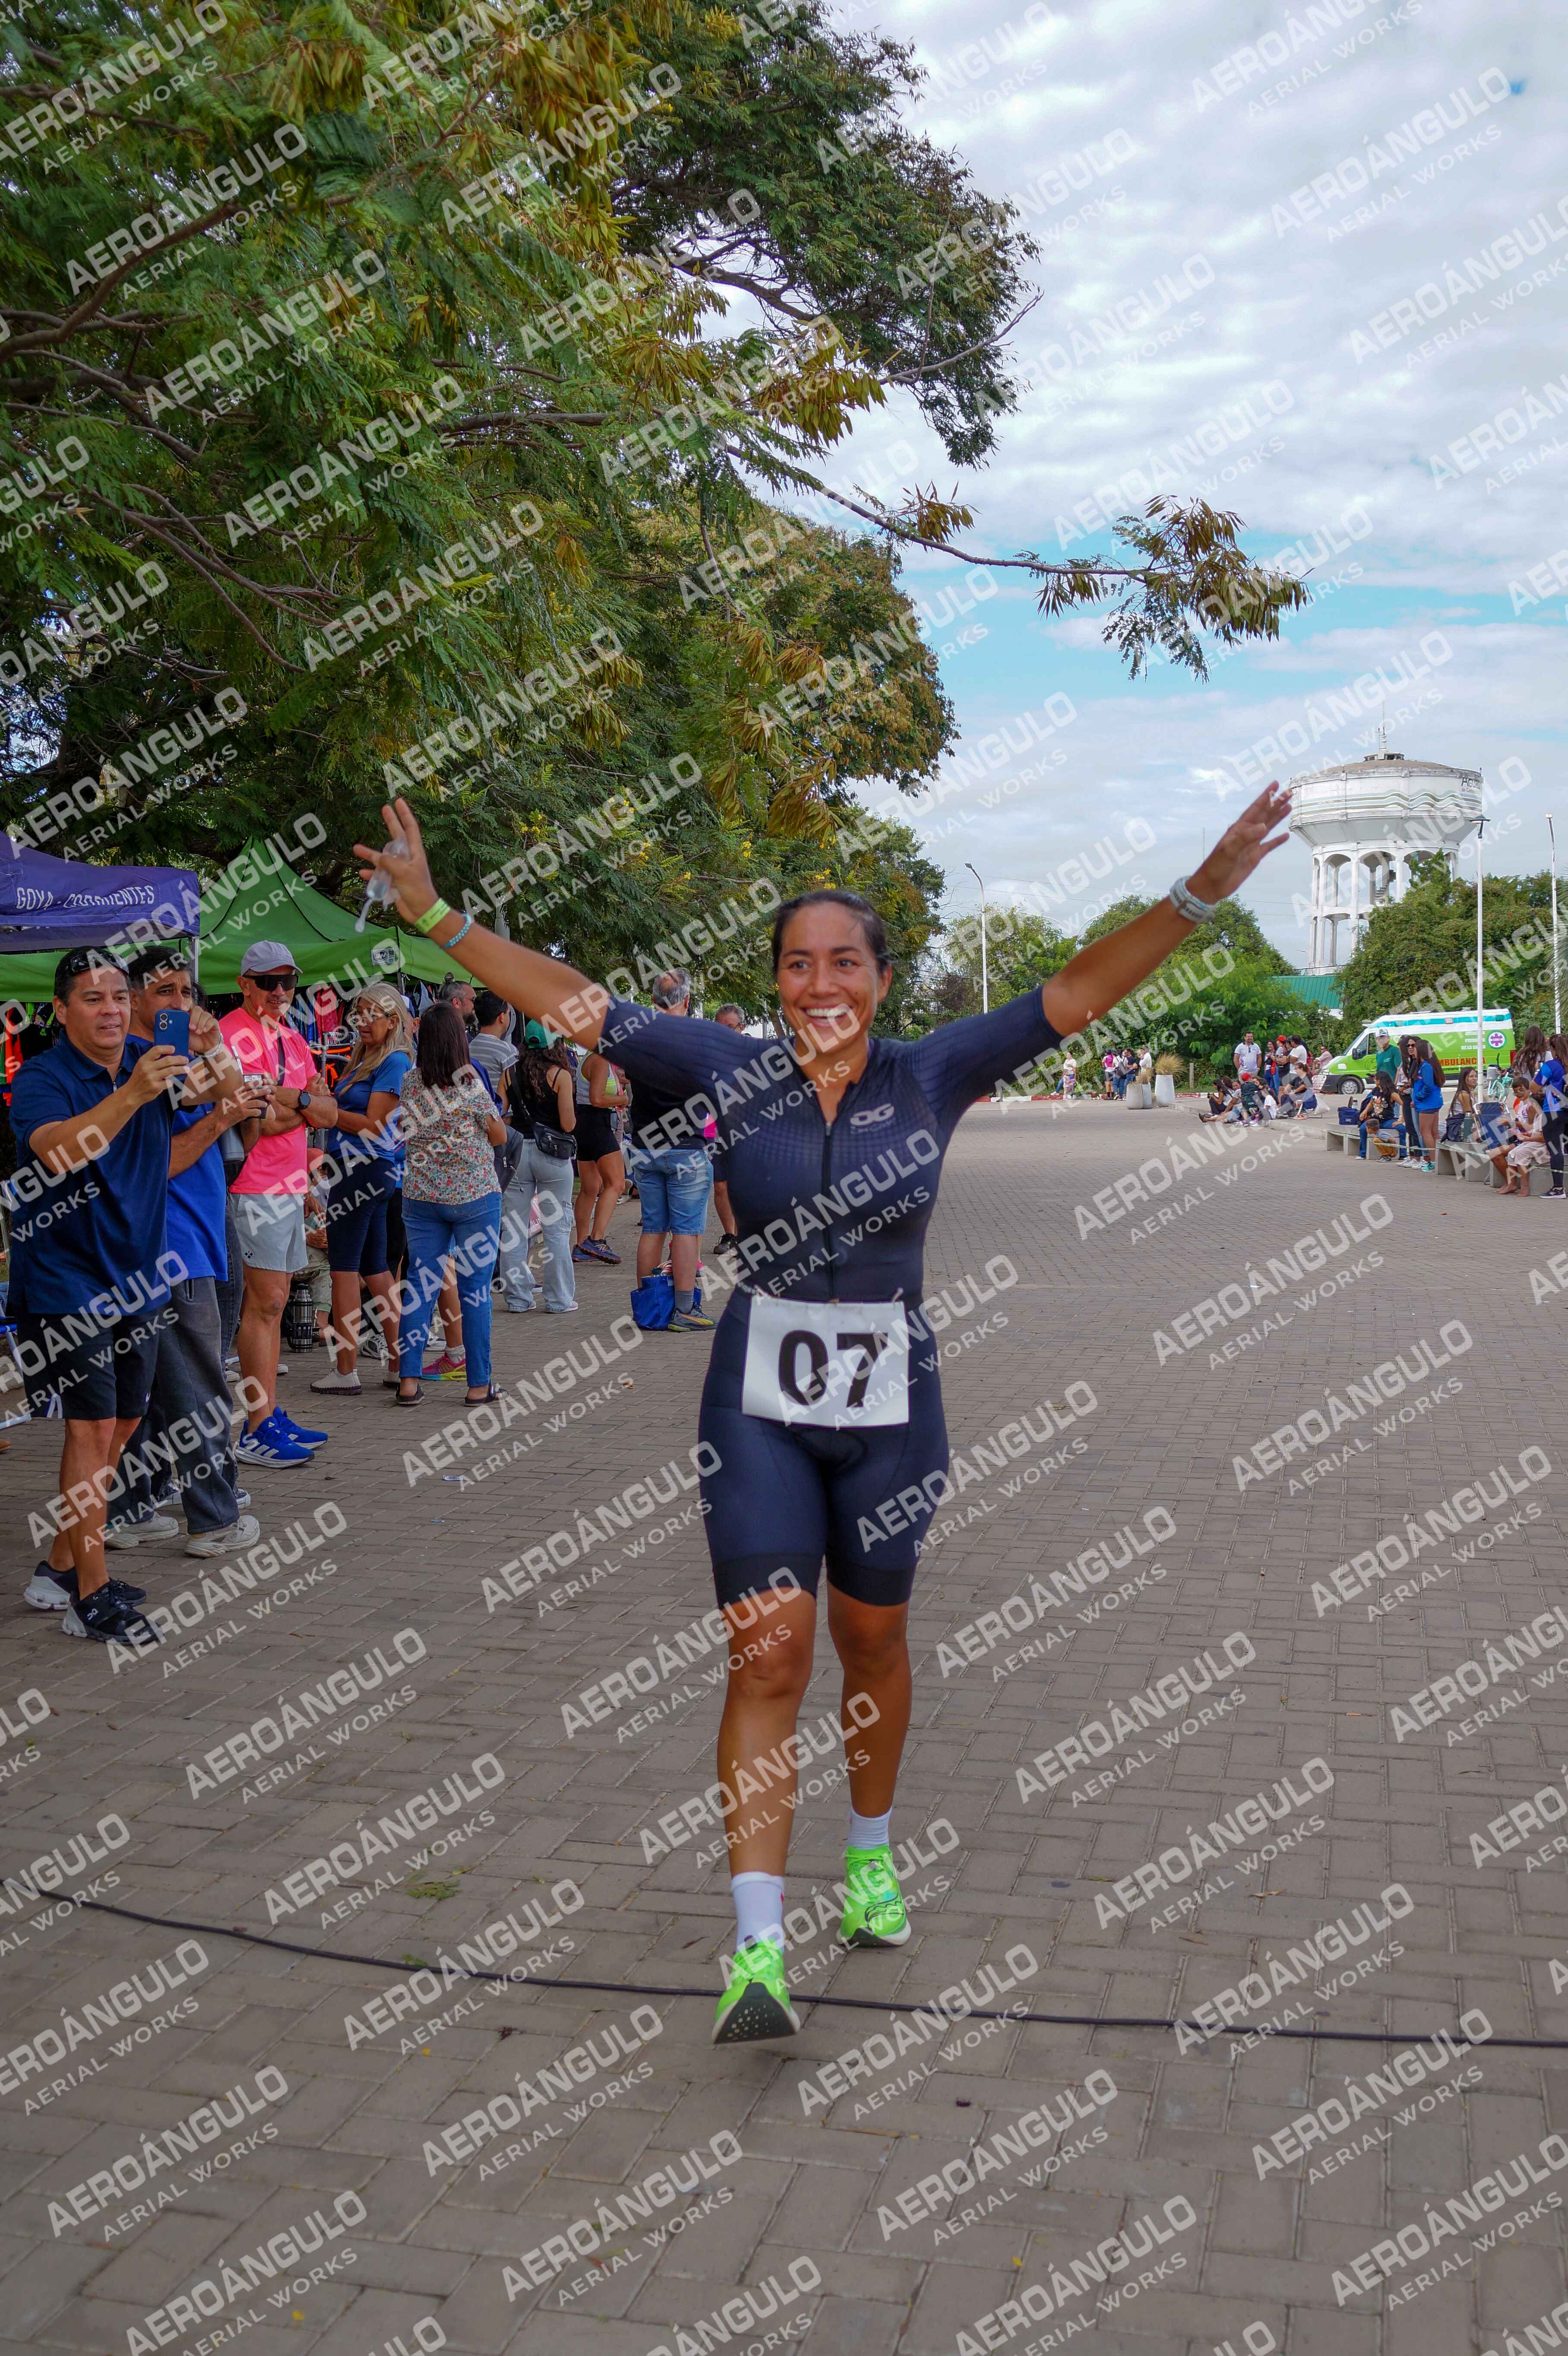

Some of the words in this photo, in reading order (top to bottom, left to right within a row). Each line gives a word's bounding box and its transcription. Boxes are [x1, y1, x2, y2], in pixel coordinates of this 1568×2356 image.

[16, 887, 54, 910] GOYA
[1439, 1057, 1486, 1066] MBULANCA
[778, 1330, 888, 1407] 07
